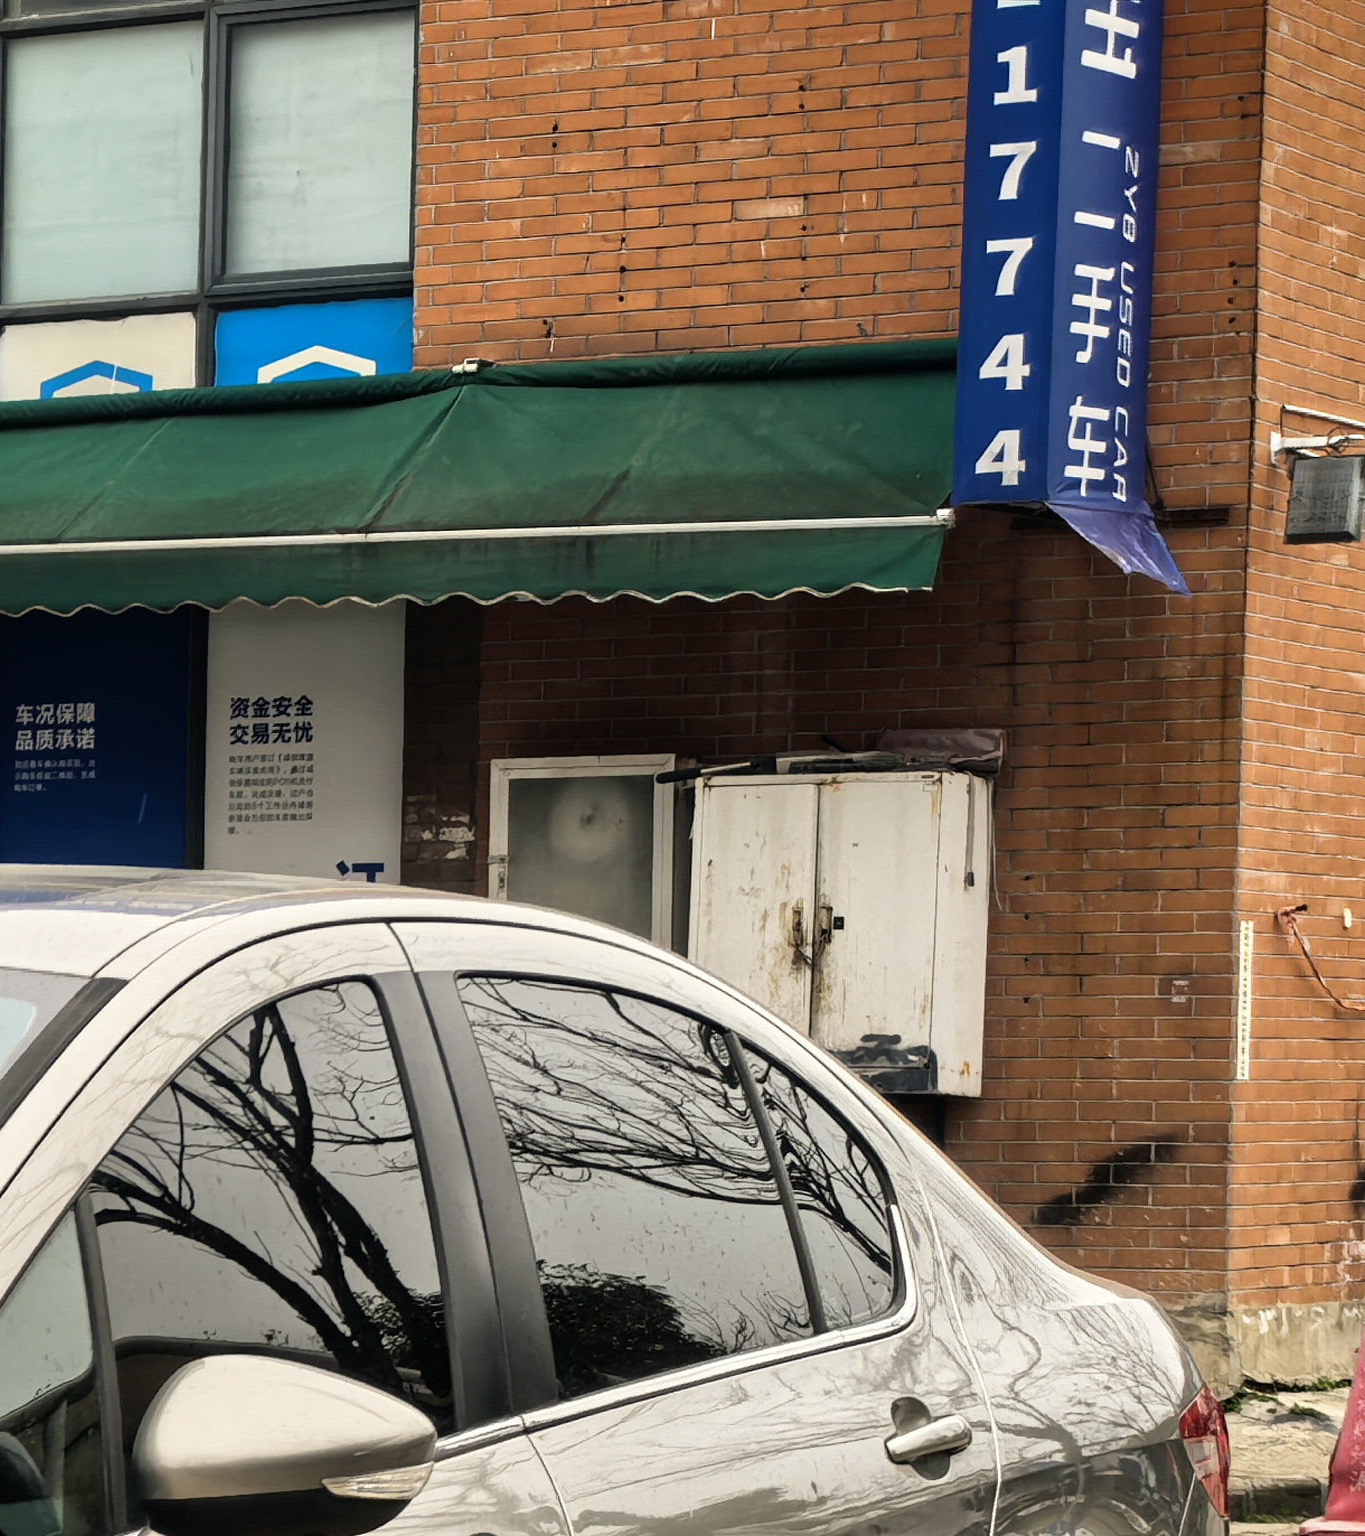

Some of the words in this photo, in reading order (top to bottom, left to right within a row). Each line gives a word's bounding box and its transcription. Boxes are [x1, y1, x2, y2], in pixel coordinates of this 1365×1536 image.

[975, 0, 1042, 486] 17744
[1116, 260, 1136, 388] USED
[1111, 406, 1129, 502] CAR
[14, 702, 96, 726] 车况保障
[230, 695, 314, 720] 资金安全
[14, 727, 96, 751] 品质承诺
[229, 722, 314, 745] 交易无忧
